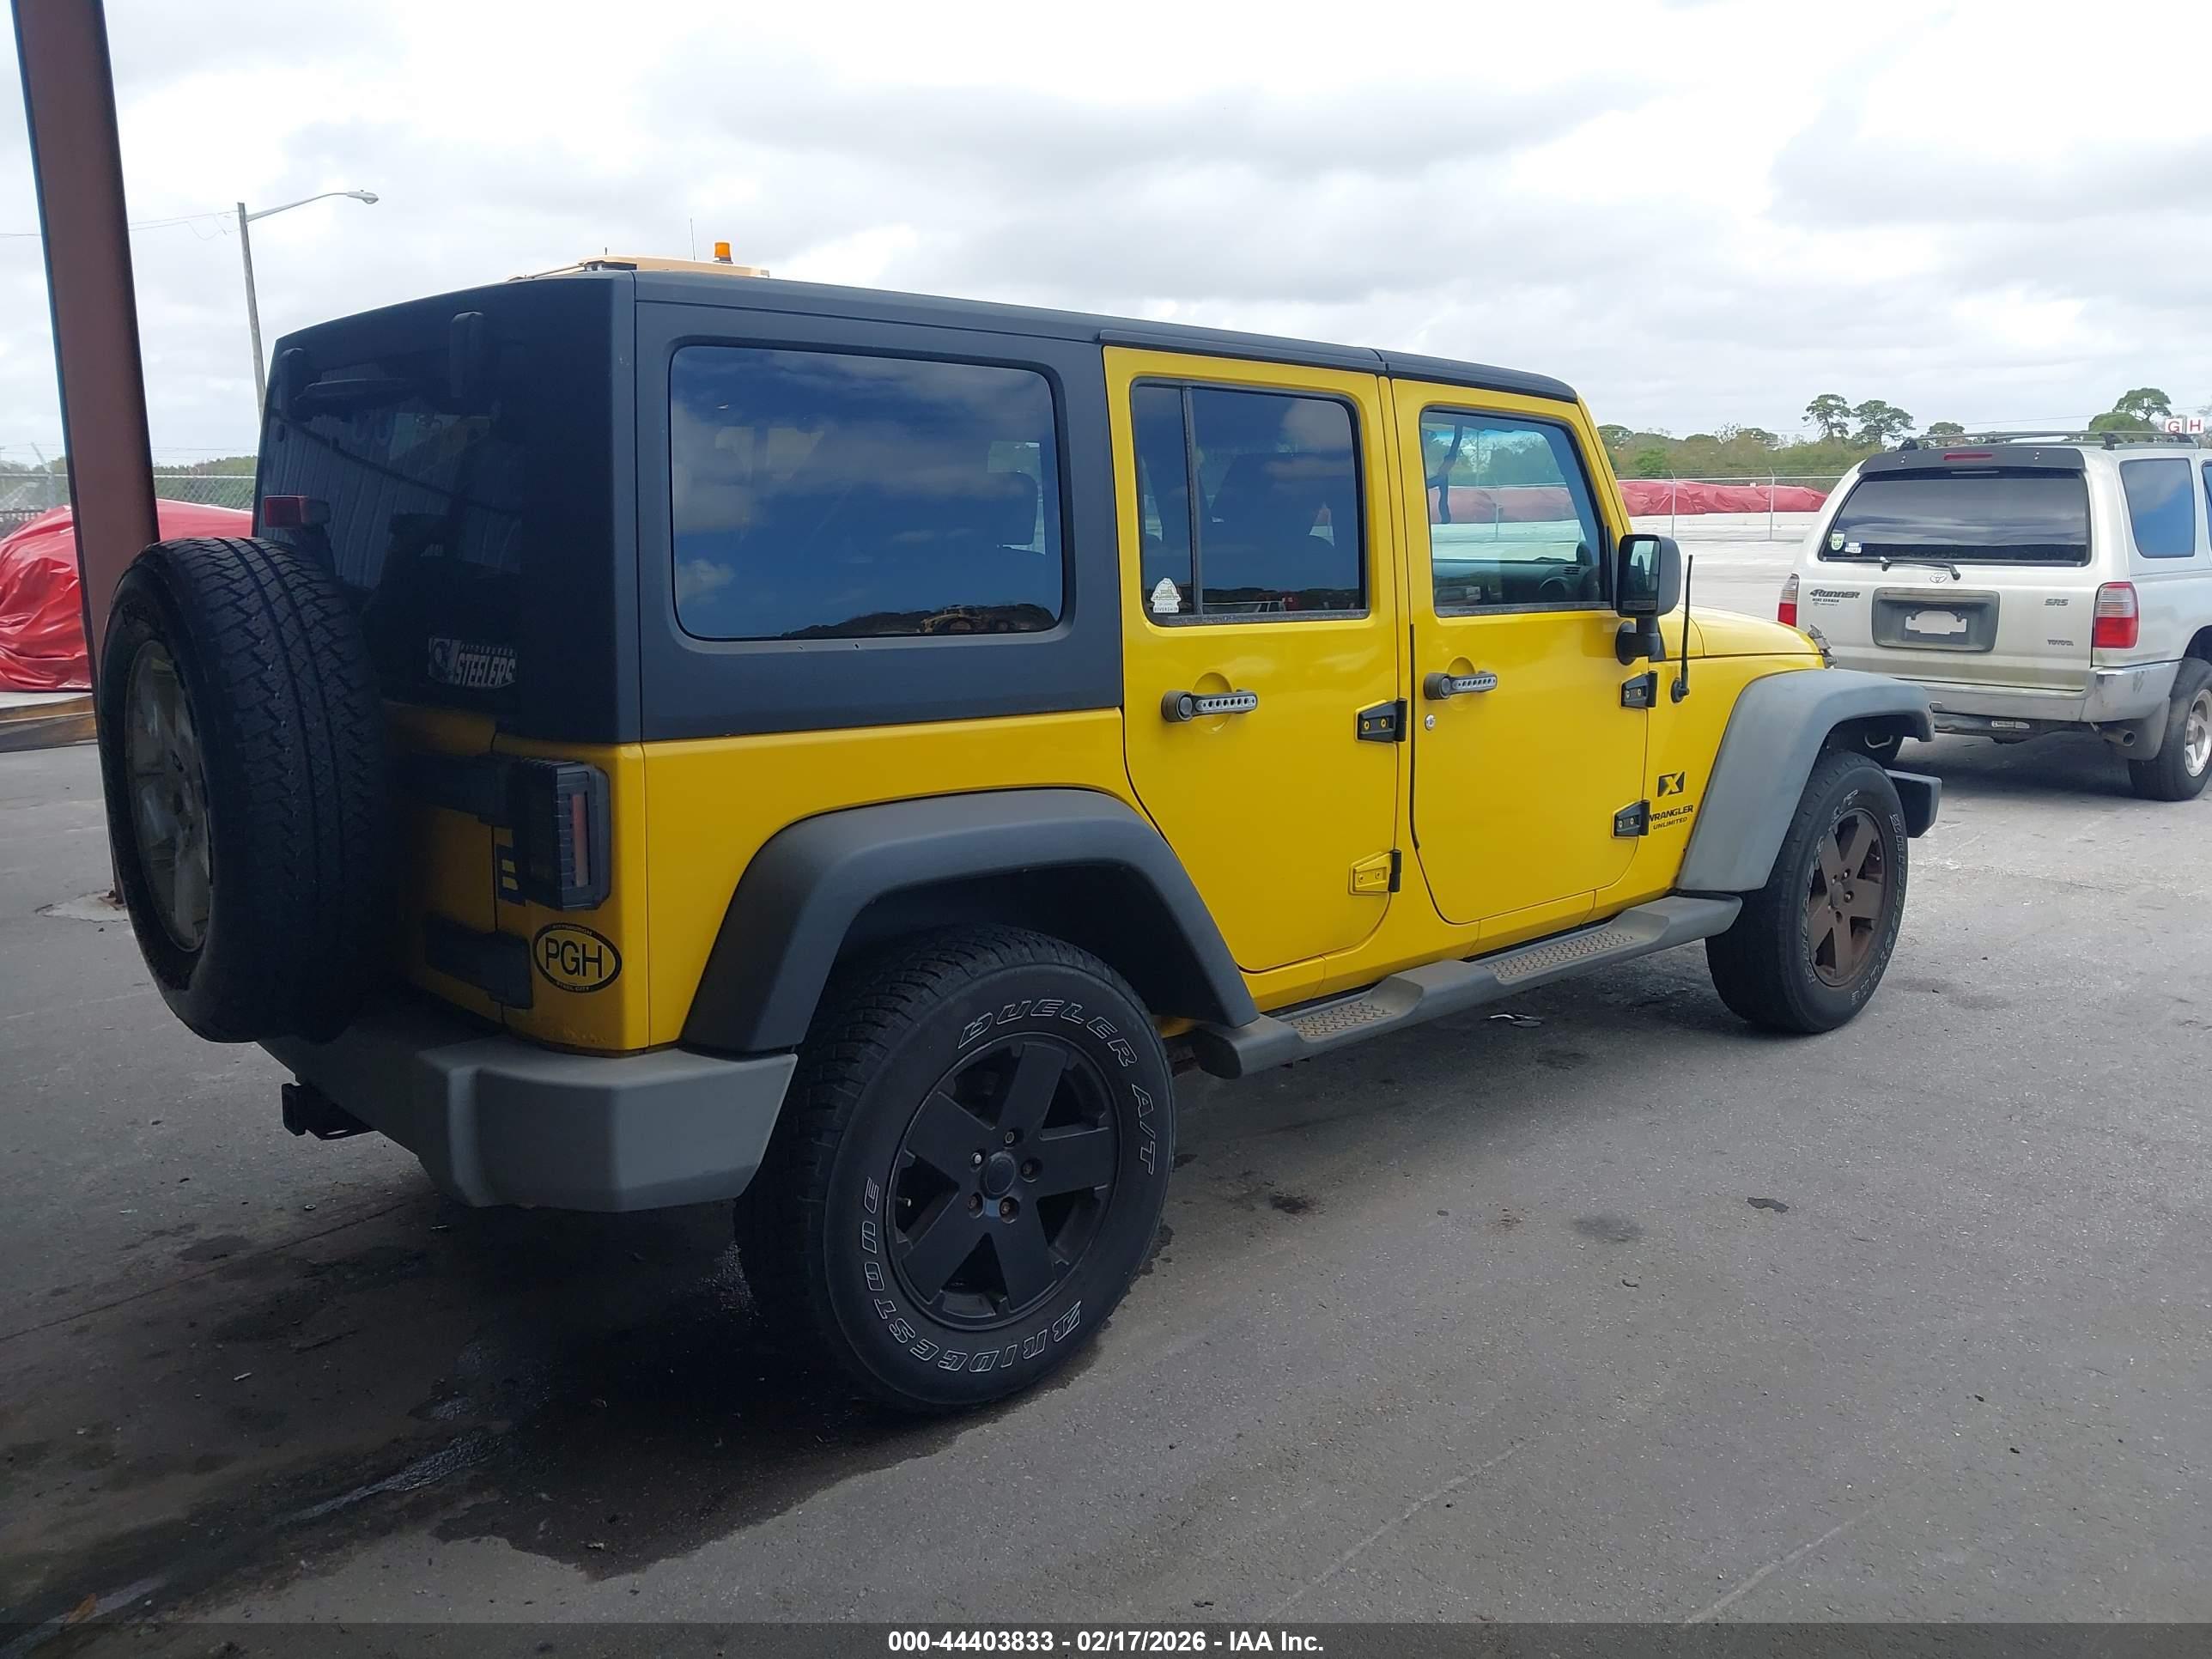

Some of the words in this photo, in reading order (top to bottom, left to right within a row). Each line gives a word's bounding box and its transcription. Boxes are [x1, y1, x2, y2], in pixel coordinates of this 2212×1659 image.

[2168, 421, 2180, 434] G
[2190, 419, 2201, 432] H
[454, 653, 515, 687] STEELERS
[1652, 817, 1688, 830] UNLIMITED
[546, 938, 602, 978] PGH
[957, 999, 1139, 1067] DUELER
[1132, 1083, 1158, 1175] A/T
[861, 1177, 1082, 1373] BRIDGESTONE
